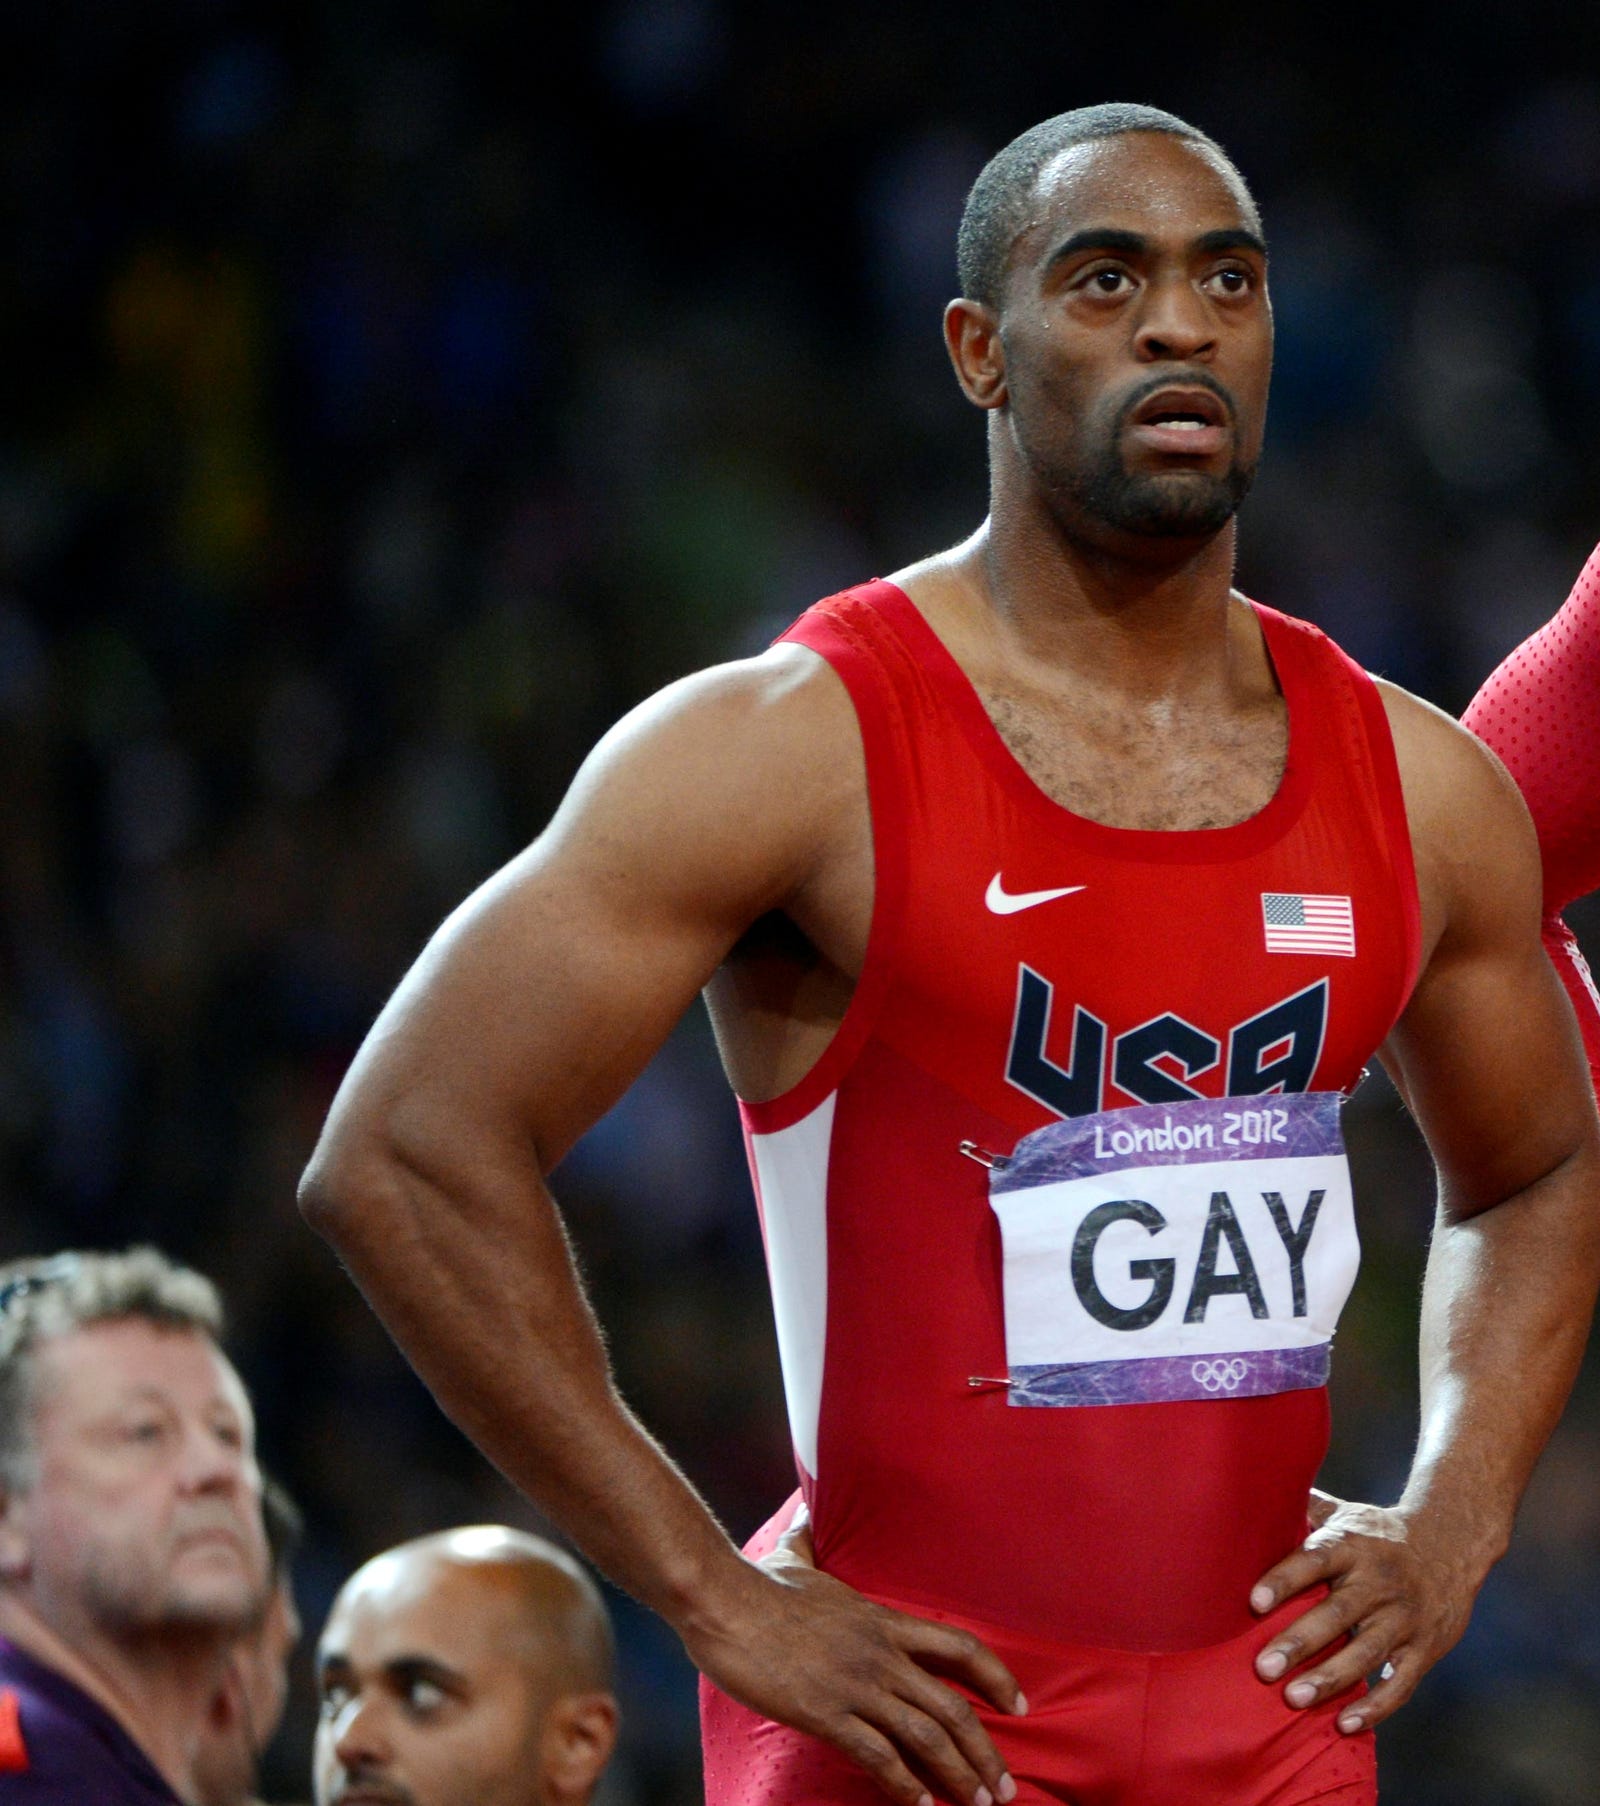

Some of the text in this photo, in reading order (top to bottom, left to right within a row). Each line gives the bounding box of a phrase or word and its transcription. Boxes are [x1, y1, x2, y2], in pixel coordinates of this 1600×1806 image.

[1004, 962, 1330, 1120] USA
[1094, 1109, 1288, 1160] London 2012
[1069, 1188, 1327, 1332] GAY
